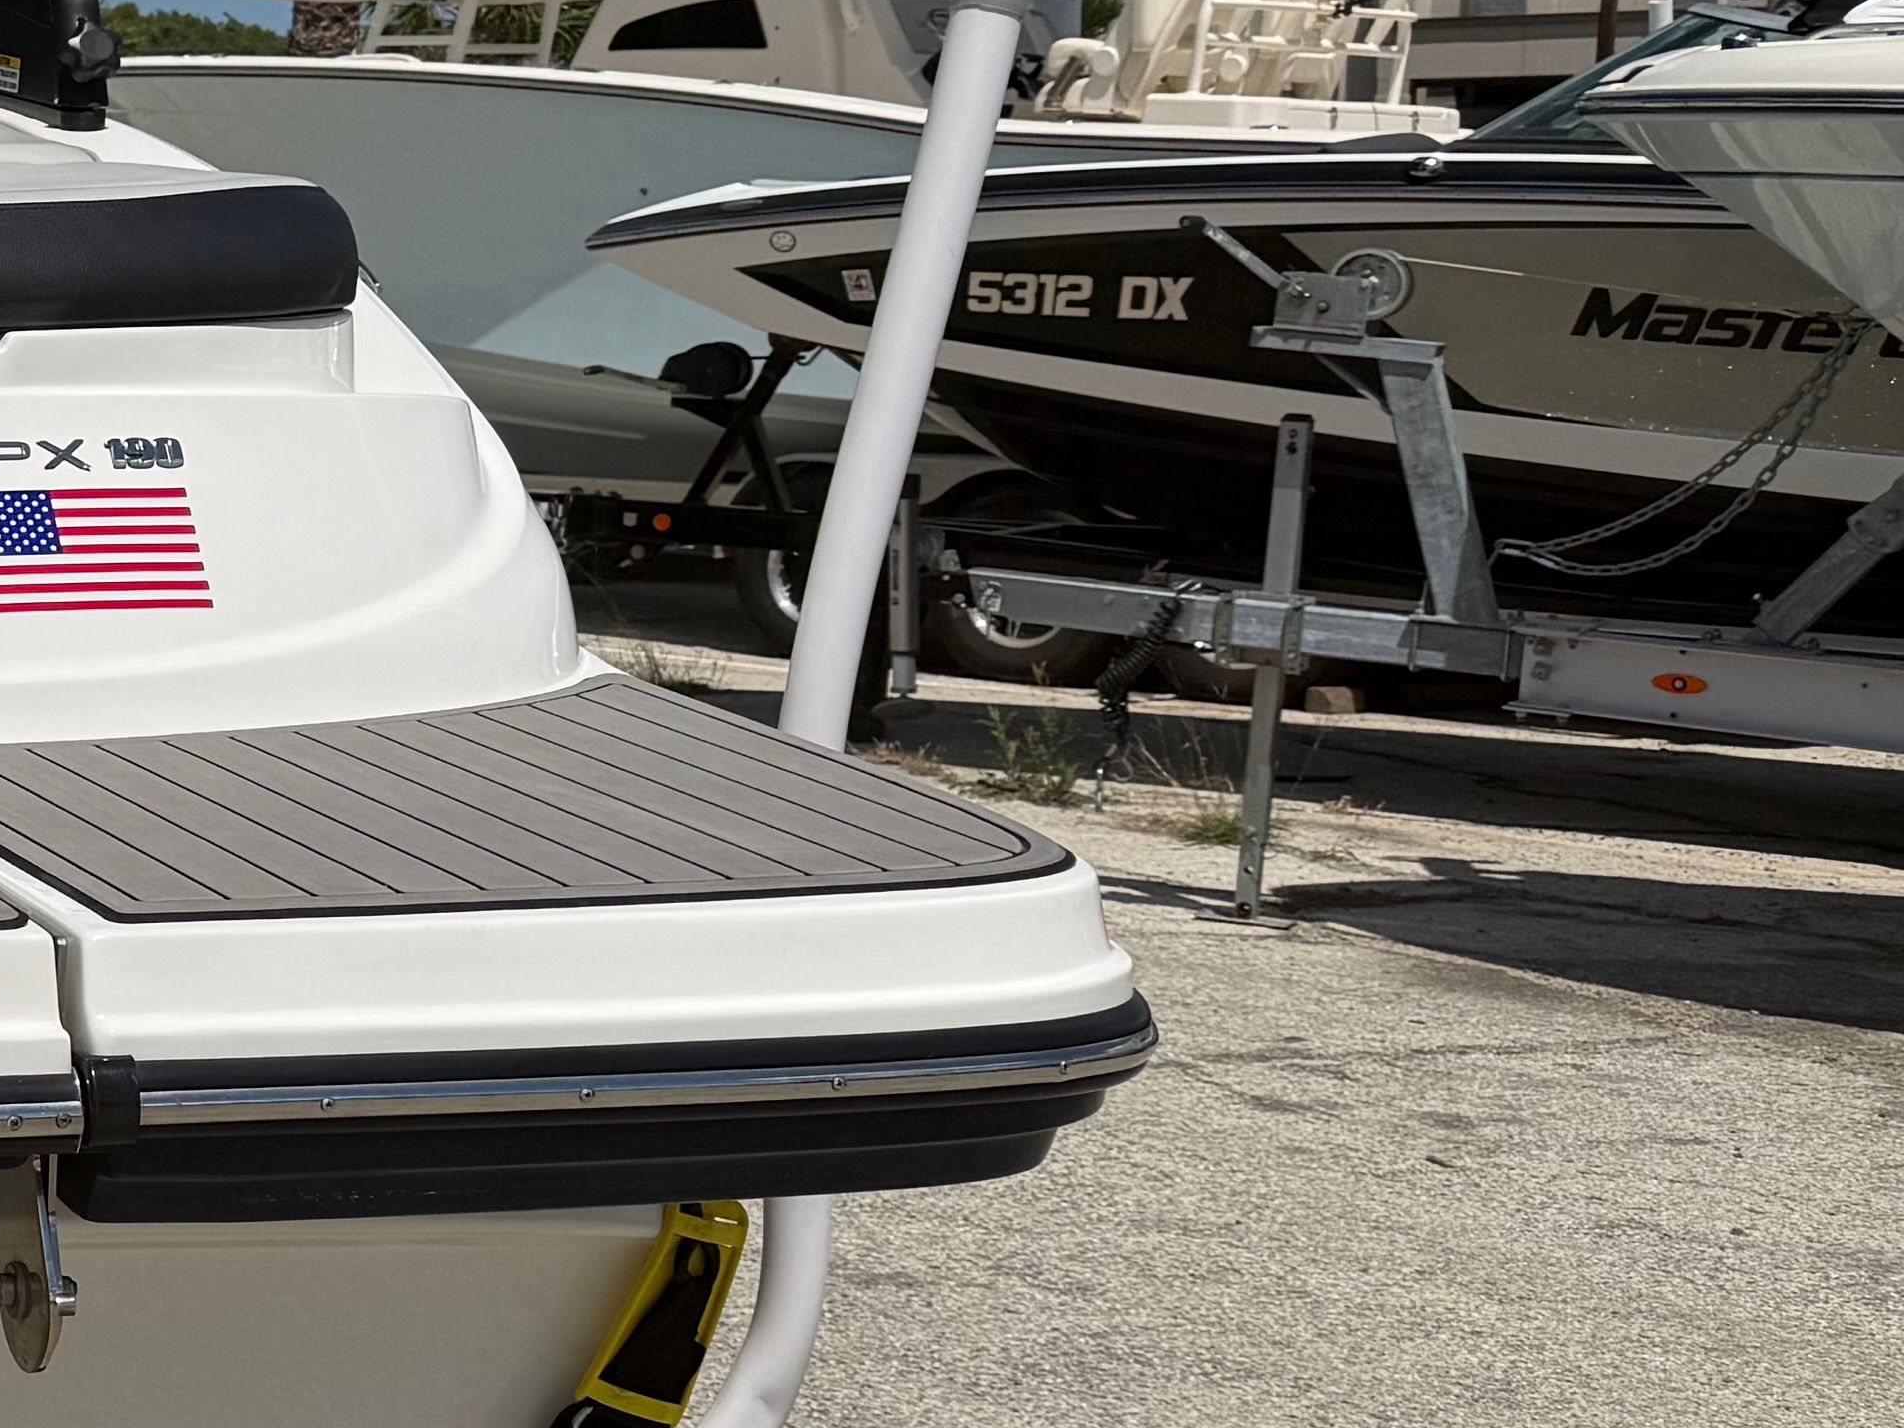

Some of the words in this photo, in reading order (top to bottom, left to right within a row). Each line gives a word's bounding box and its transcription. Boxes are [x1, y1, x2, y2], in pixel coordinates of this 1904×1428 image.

[967, 272, 1093, 317] 5312
[1117, 275, 1194, 320] DX
[104, 437, 185, 470] 190
